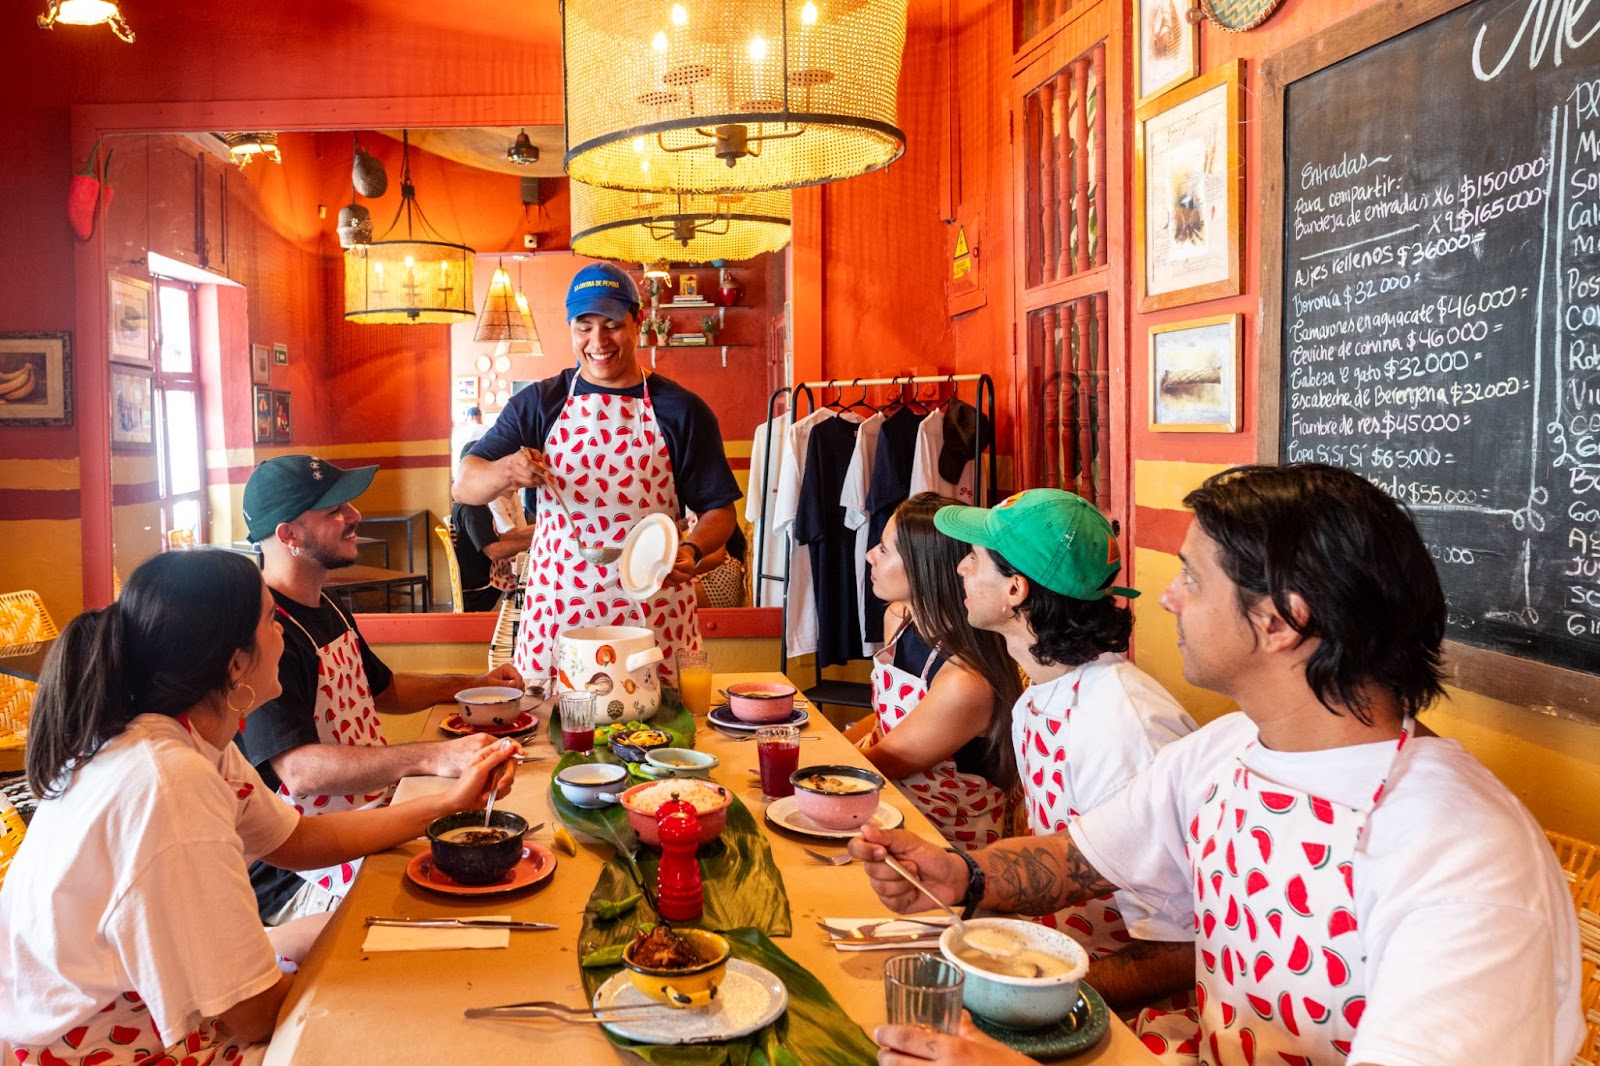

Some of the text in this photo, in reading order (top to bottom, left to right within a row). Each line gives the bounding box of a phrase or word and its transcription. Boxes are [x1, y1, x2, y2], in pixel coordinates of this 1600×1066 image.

[1301, 152, 1368, 190] Entradas
[1571, 168, 1600, 199] So
[1329, 174, 1402, 217] compartir:
[1294, 217, 1345, 241] Bandeja
[1346, 209, 1361, 227] de
[1364, 192, 1428, 221] entradas
[1568, 202, 1600, 231] Cal
[1332, 245, 1393, 275] rellenos
[1290, 319, 1355, 343] Camarones
[1290, 345, 1334, 367] Ceviche
[1338, 340, 1353, 361] de
[1354, 337, 1404, 357] corvina
[1290, 365, 1337, 390] Cabeza
[1353, 364, 1381, 390] gato
[1291, 388, 1352, 410] Escabeche
[1354, 388, 1371, 408] de
[1292, 412, 1338, 437] Fiambre
[1339, 413, 1354, 435] de
[1357, 416, 1381, 435] res
